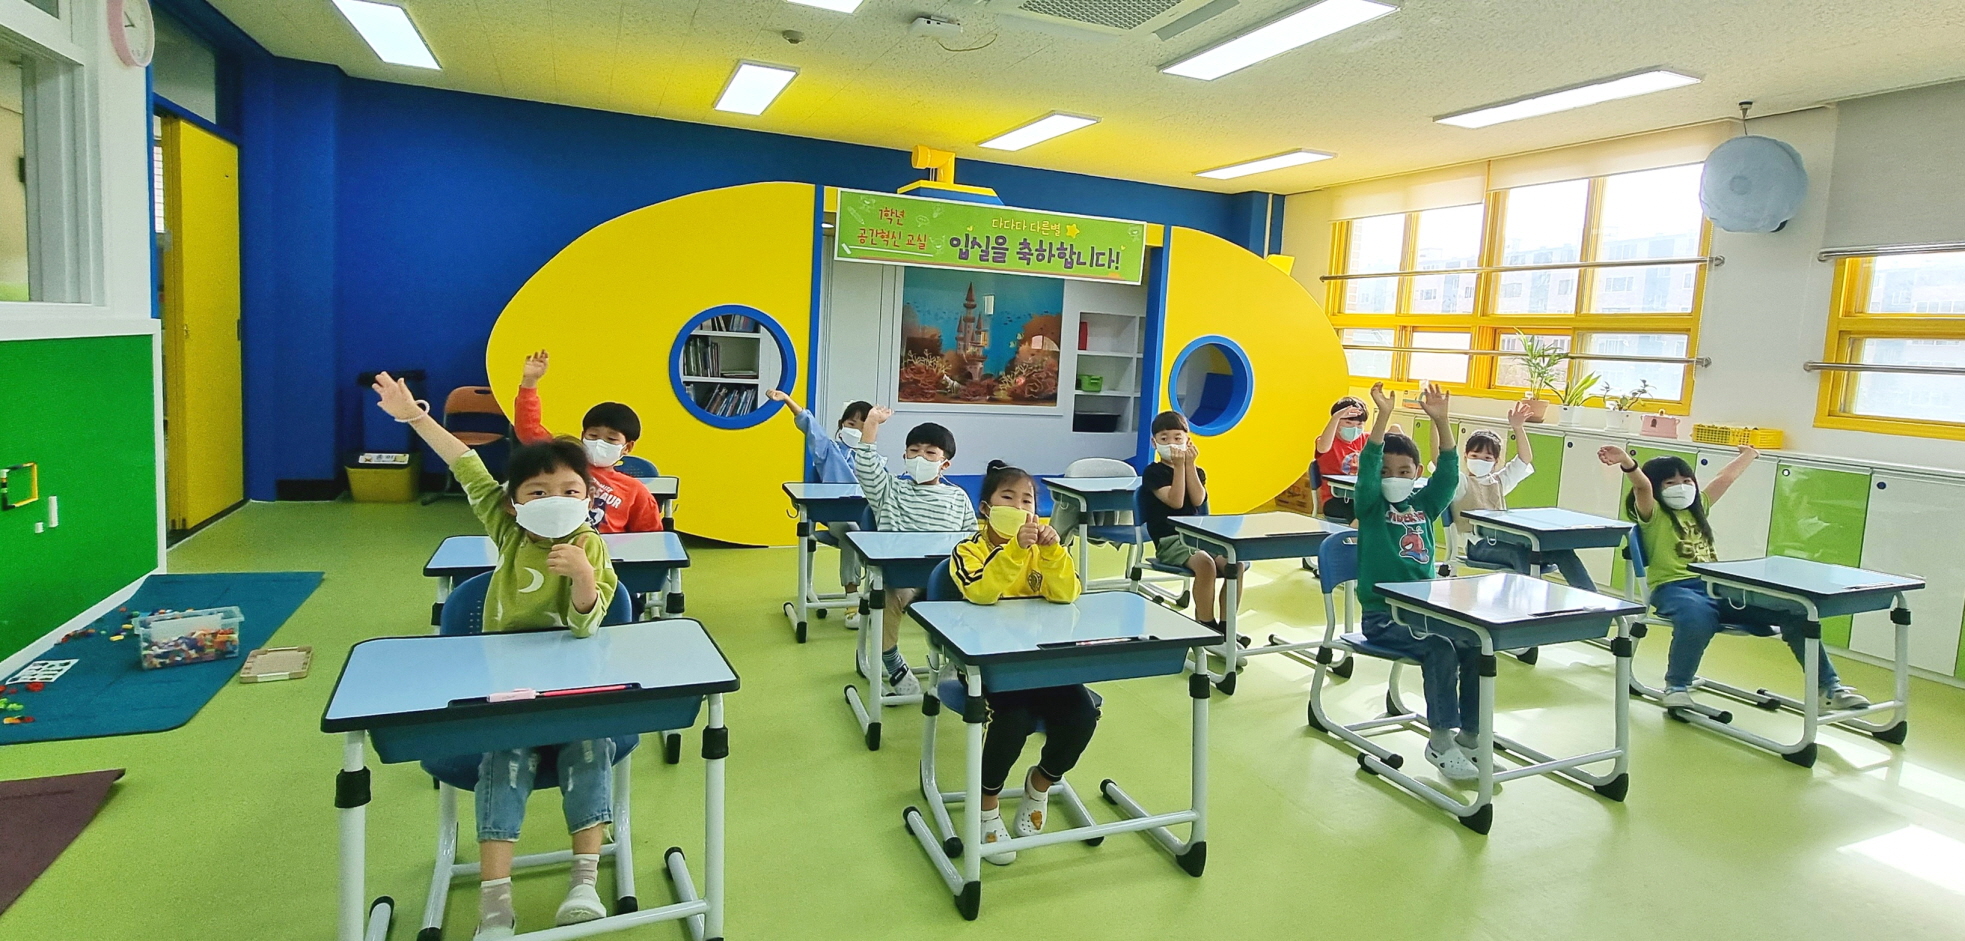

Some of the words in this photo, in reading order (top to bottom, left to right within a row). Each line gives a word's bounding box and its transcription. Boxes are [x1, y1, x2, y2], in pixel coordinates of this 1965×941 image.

[879, 206, 905, 226] 1학년
[992, 217, 1027, 231] 다다다
[1030, 220, 1061, 237] 다른별
[858, 228, 902, 247] 공간혁신
[906, 234, 927, 250] 교실
[949, 233, 1010, 264] 입실을
[1016, 237, 1120, 271] 축하합니다!
